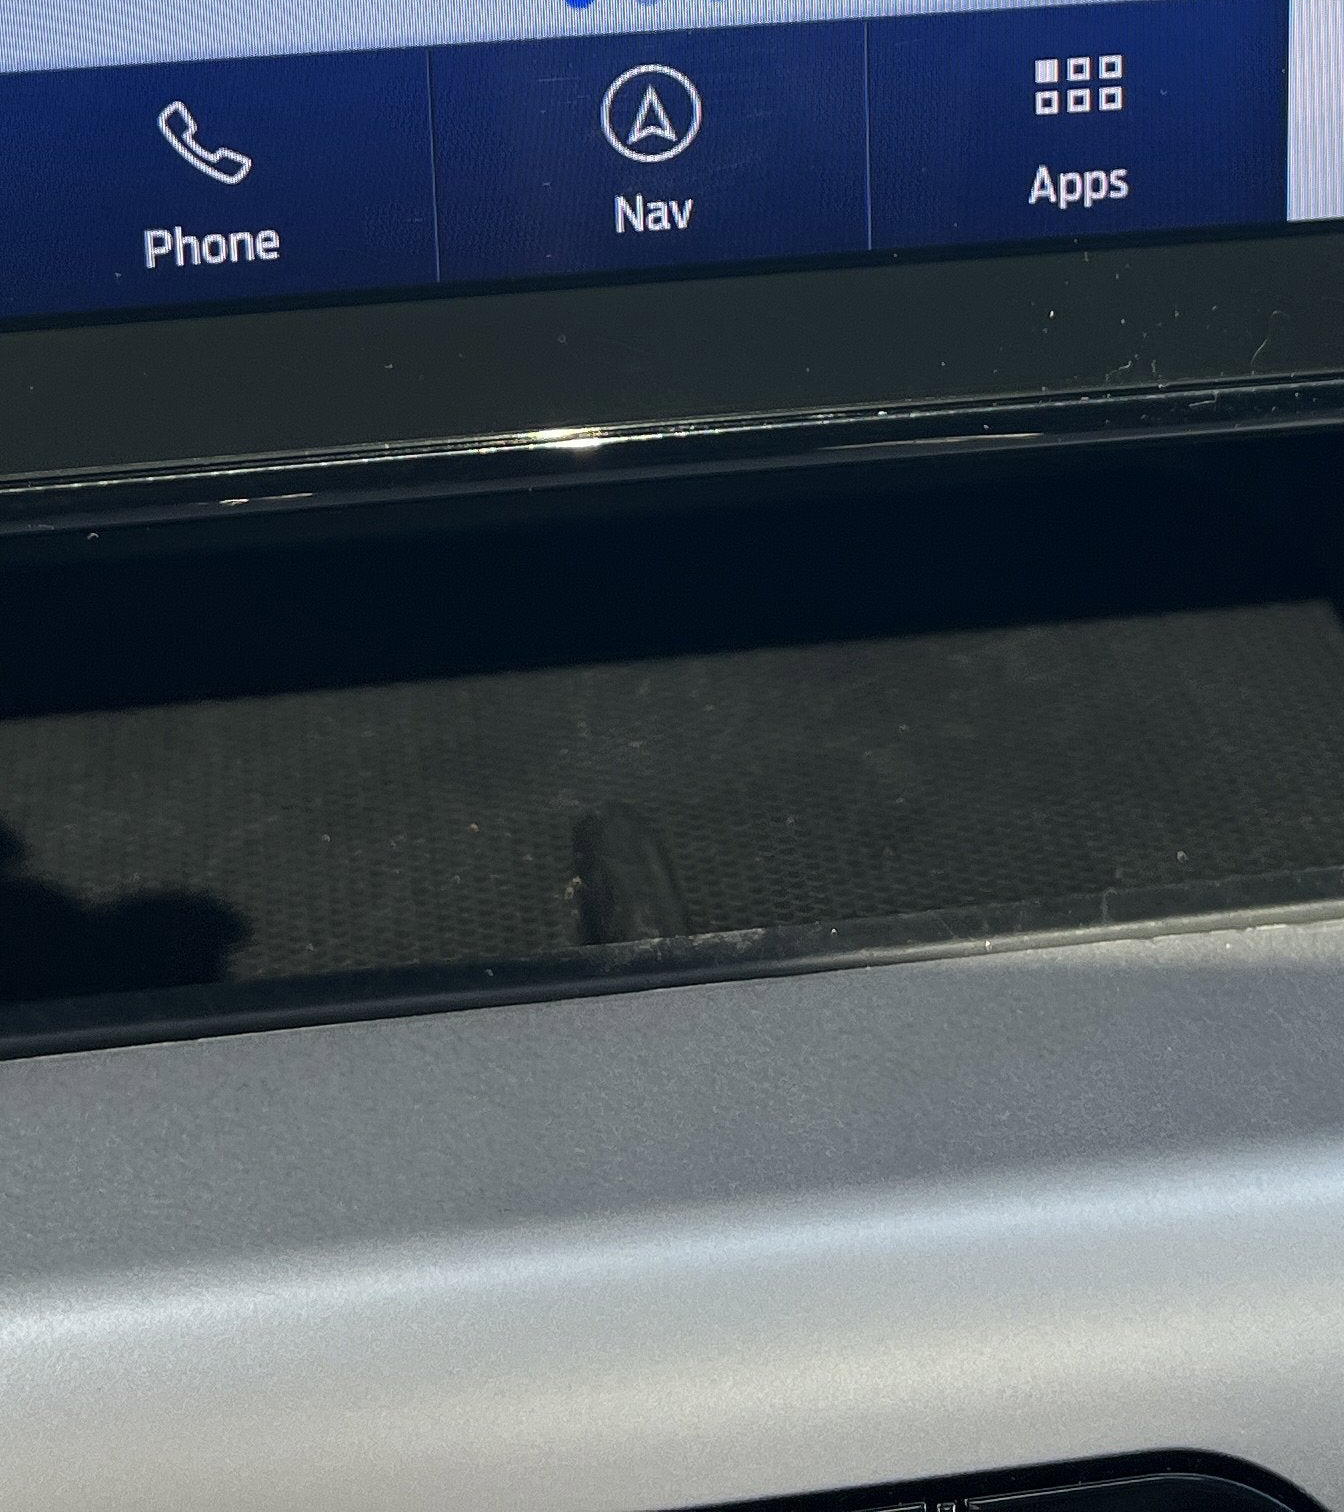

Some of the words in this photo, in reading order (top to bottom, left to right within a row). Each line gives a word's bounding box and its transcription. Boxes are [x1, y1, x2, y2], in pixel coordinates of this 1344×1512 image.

[1027, 164, 1130, 211] Apps
[613, 194, 694, 234] Nav
[142, 226, 282, 269] Phone
